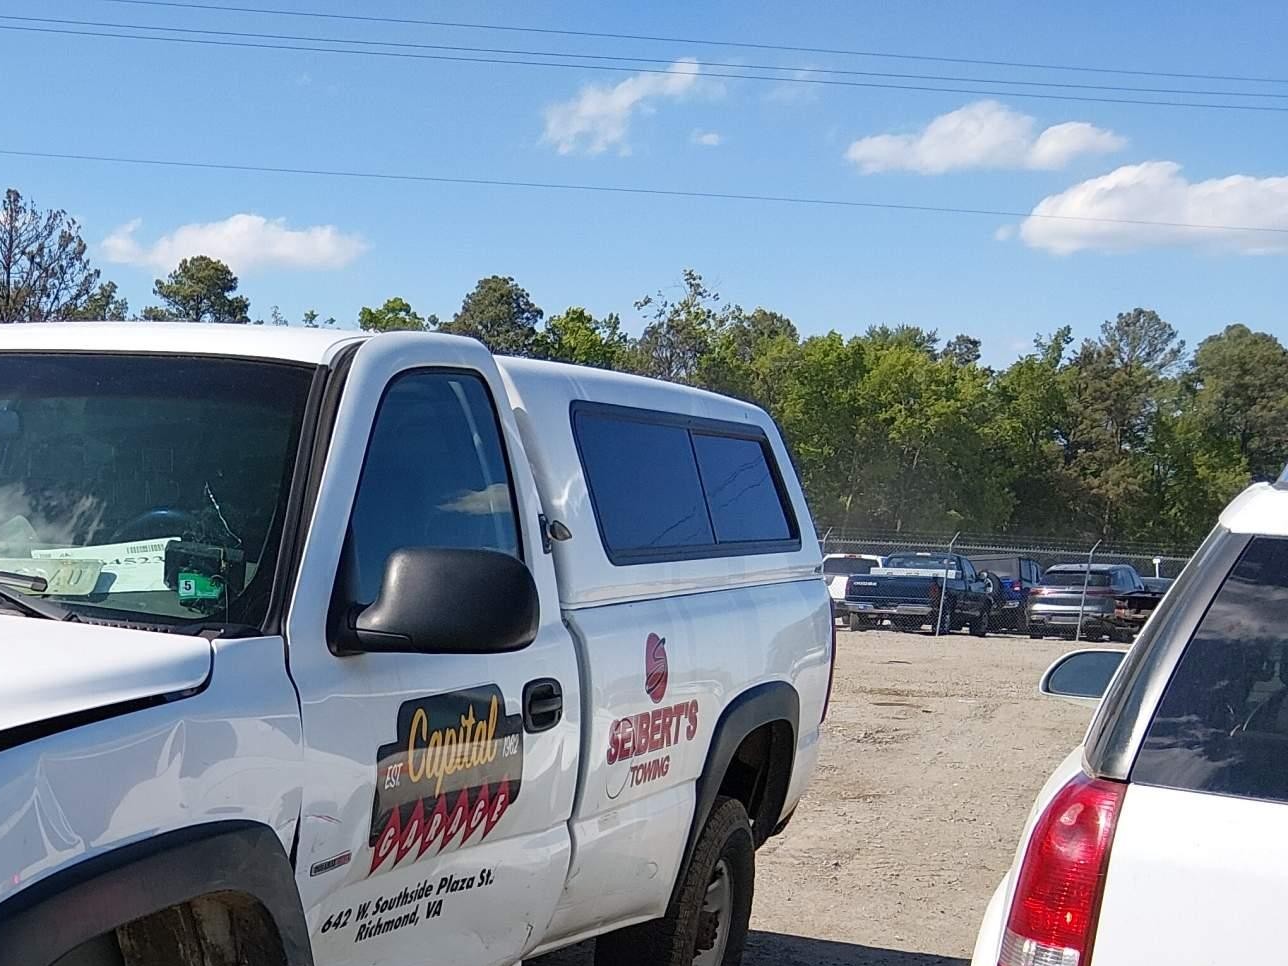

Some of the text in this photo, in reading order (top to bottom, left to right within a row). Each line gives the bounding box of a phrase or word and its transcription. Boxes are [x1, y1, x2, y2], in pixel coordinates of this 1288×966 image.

[184, 580, 192, 591] 5
[408, 694, 500, 799] Capital
[606, 699, 699, 766] SEIBERT'S
[630, 754, 670, 788] TOWING
[379, 794, 505, 857] GARAGE
[321, 868, 494, 933] 642 W. Southside Plaza St.
[354, 899, 444, 943] Richmond, VA
